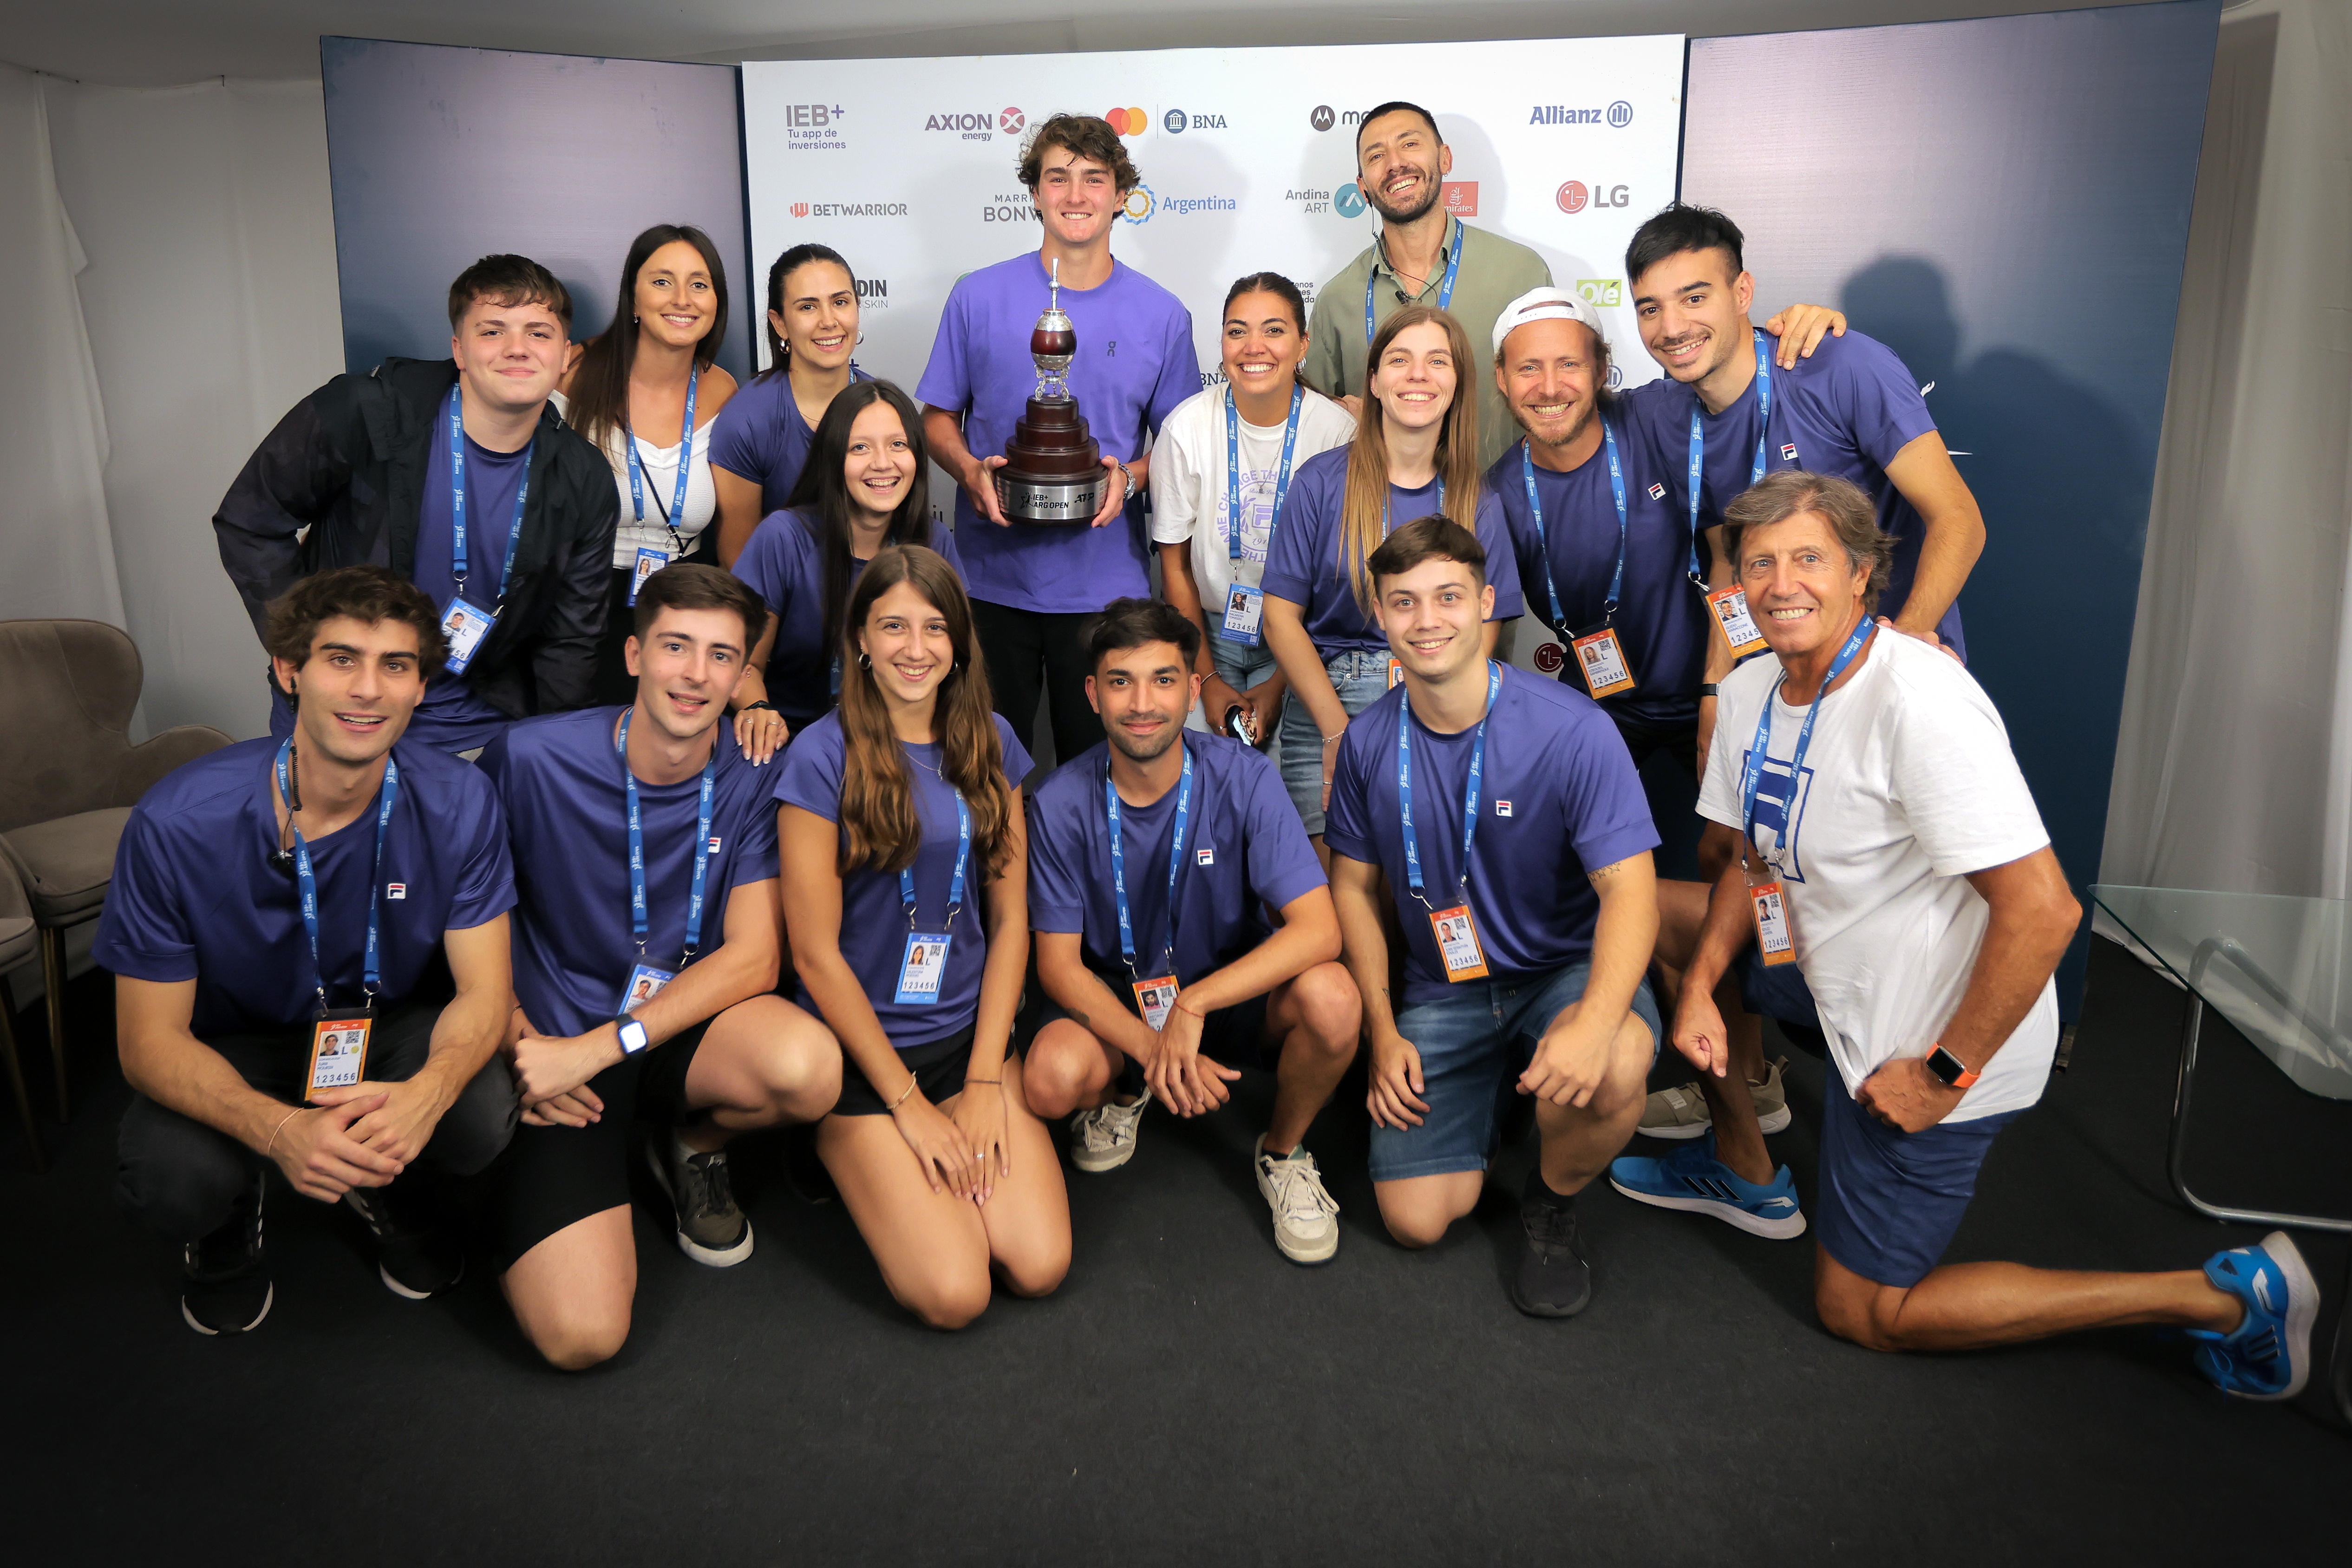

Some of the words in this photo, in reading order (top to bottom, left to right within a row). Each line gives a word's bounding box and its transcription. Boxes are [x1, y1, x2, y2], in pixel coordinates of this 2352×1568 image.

[786, 104, 844, 127] IEB+
[1192, 115, 1228, 128] BNA
[1529, 105, 1602, 125] Allianz
[925, 114, 992, 131] AXION
[787, 129, 799, 137] Tu
[802, 130, 822, 139] app
[824, 129, 837, 137] de
[962, 132, 992, 141] energy
[788, 140, 846, 149] inversiones
[995, 194, 1032, 203] MARRI
[1285, 189, 1329, 200] Andina
[1594, 185, 1629, 208] LG
[813, 203, 908, 216] BETWARRIOR
[1163, 195, 1236, 215] Argentina
[1304, 203, 1329, 213] ART
[984, 206, 1038, 222] BONV
[856, 280, 887, 297] DIN
[1579, 281, 1619, 304] Olé
[864, 300, 888, 308] SKIN
[1074, 492, 1095, 503] ATP
[1218, 470, 1257, 511] CHNGE
[1261, 470, 1277, 481] TH
[1217, 516, 1230, 543] AME
[1731, 628, 1759, 643] 12345
[1842, 648, 1851, 657] OPEN
